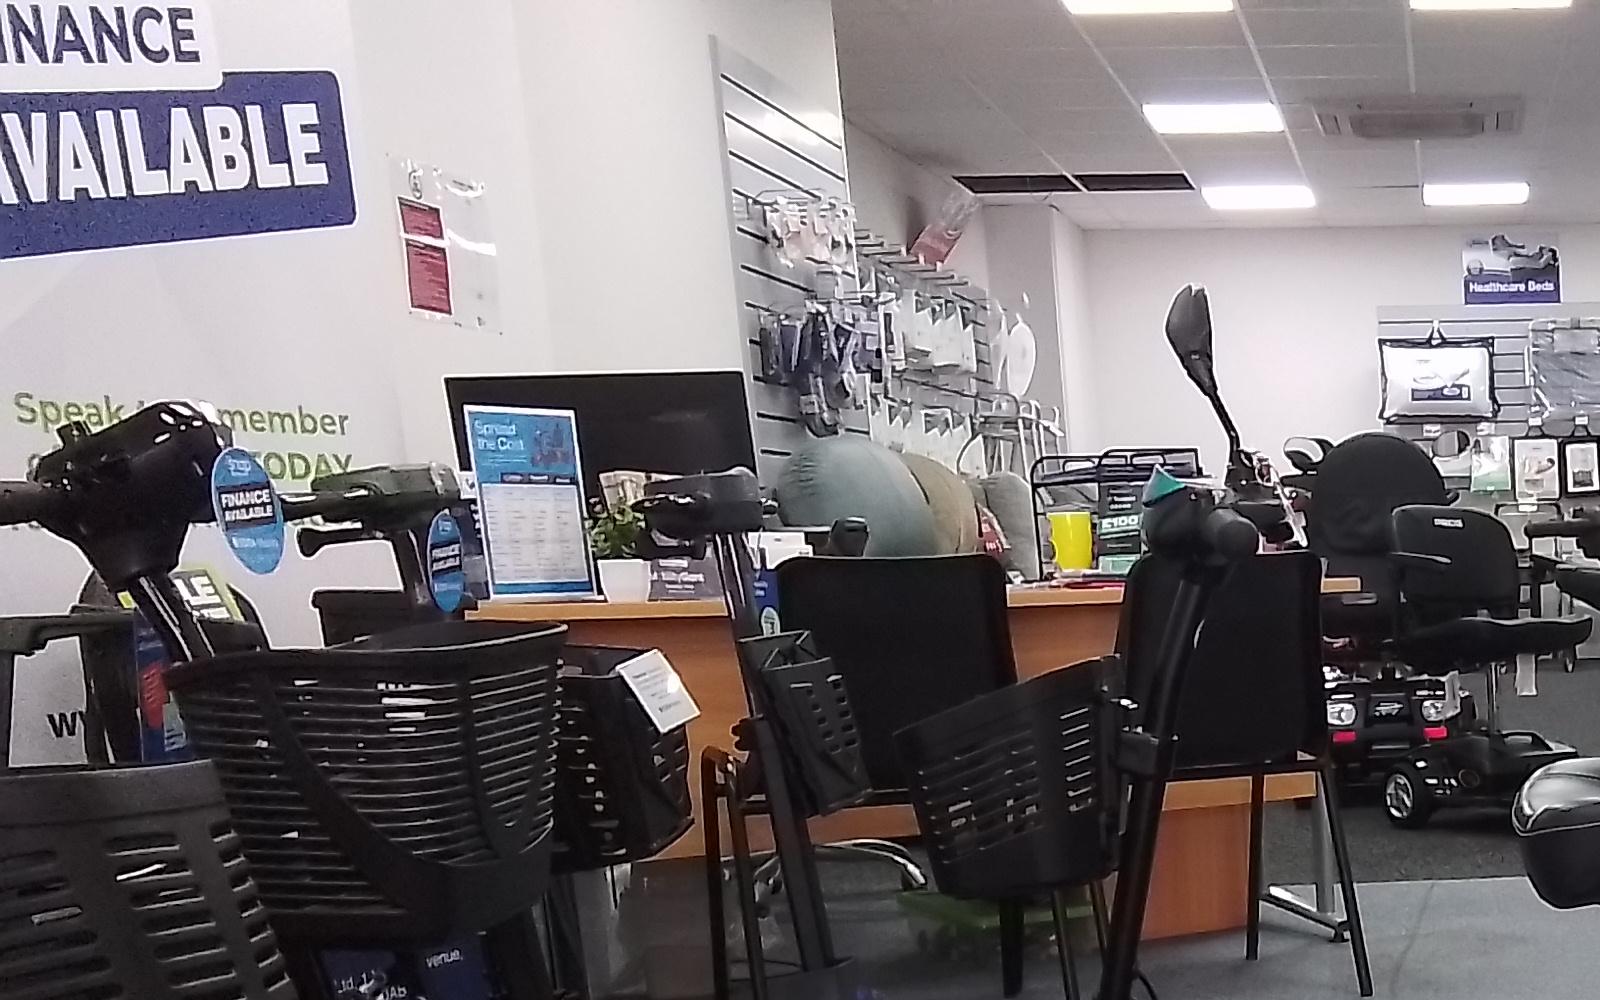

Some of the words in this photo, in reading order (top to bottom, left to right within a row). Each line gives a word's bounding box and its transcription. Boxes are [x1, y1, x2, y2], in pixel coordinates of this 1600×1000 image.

[1469, 281, 1525, 293] Healthcare
[1528, 280, 1555, 292] Beds
[14, 392, 124, 433] Speak
[217, 405, 349, 435] member
[221, 489, 272, 508] FINANCE
